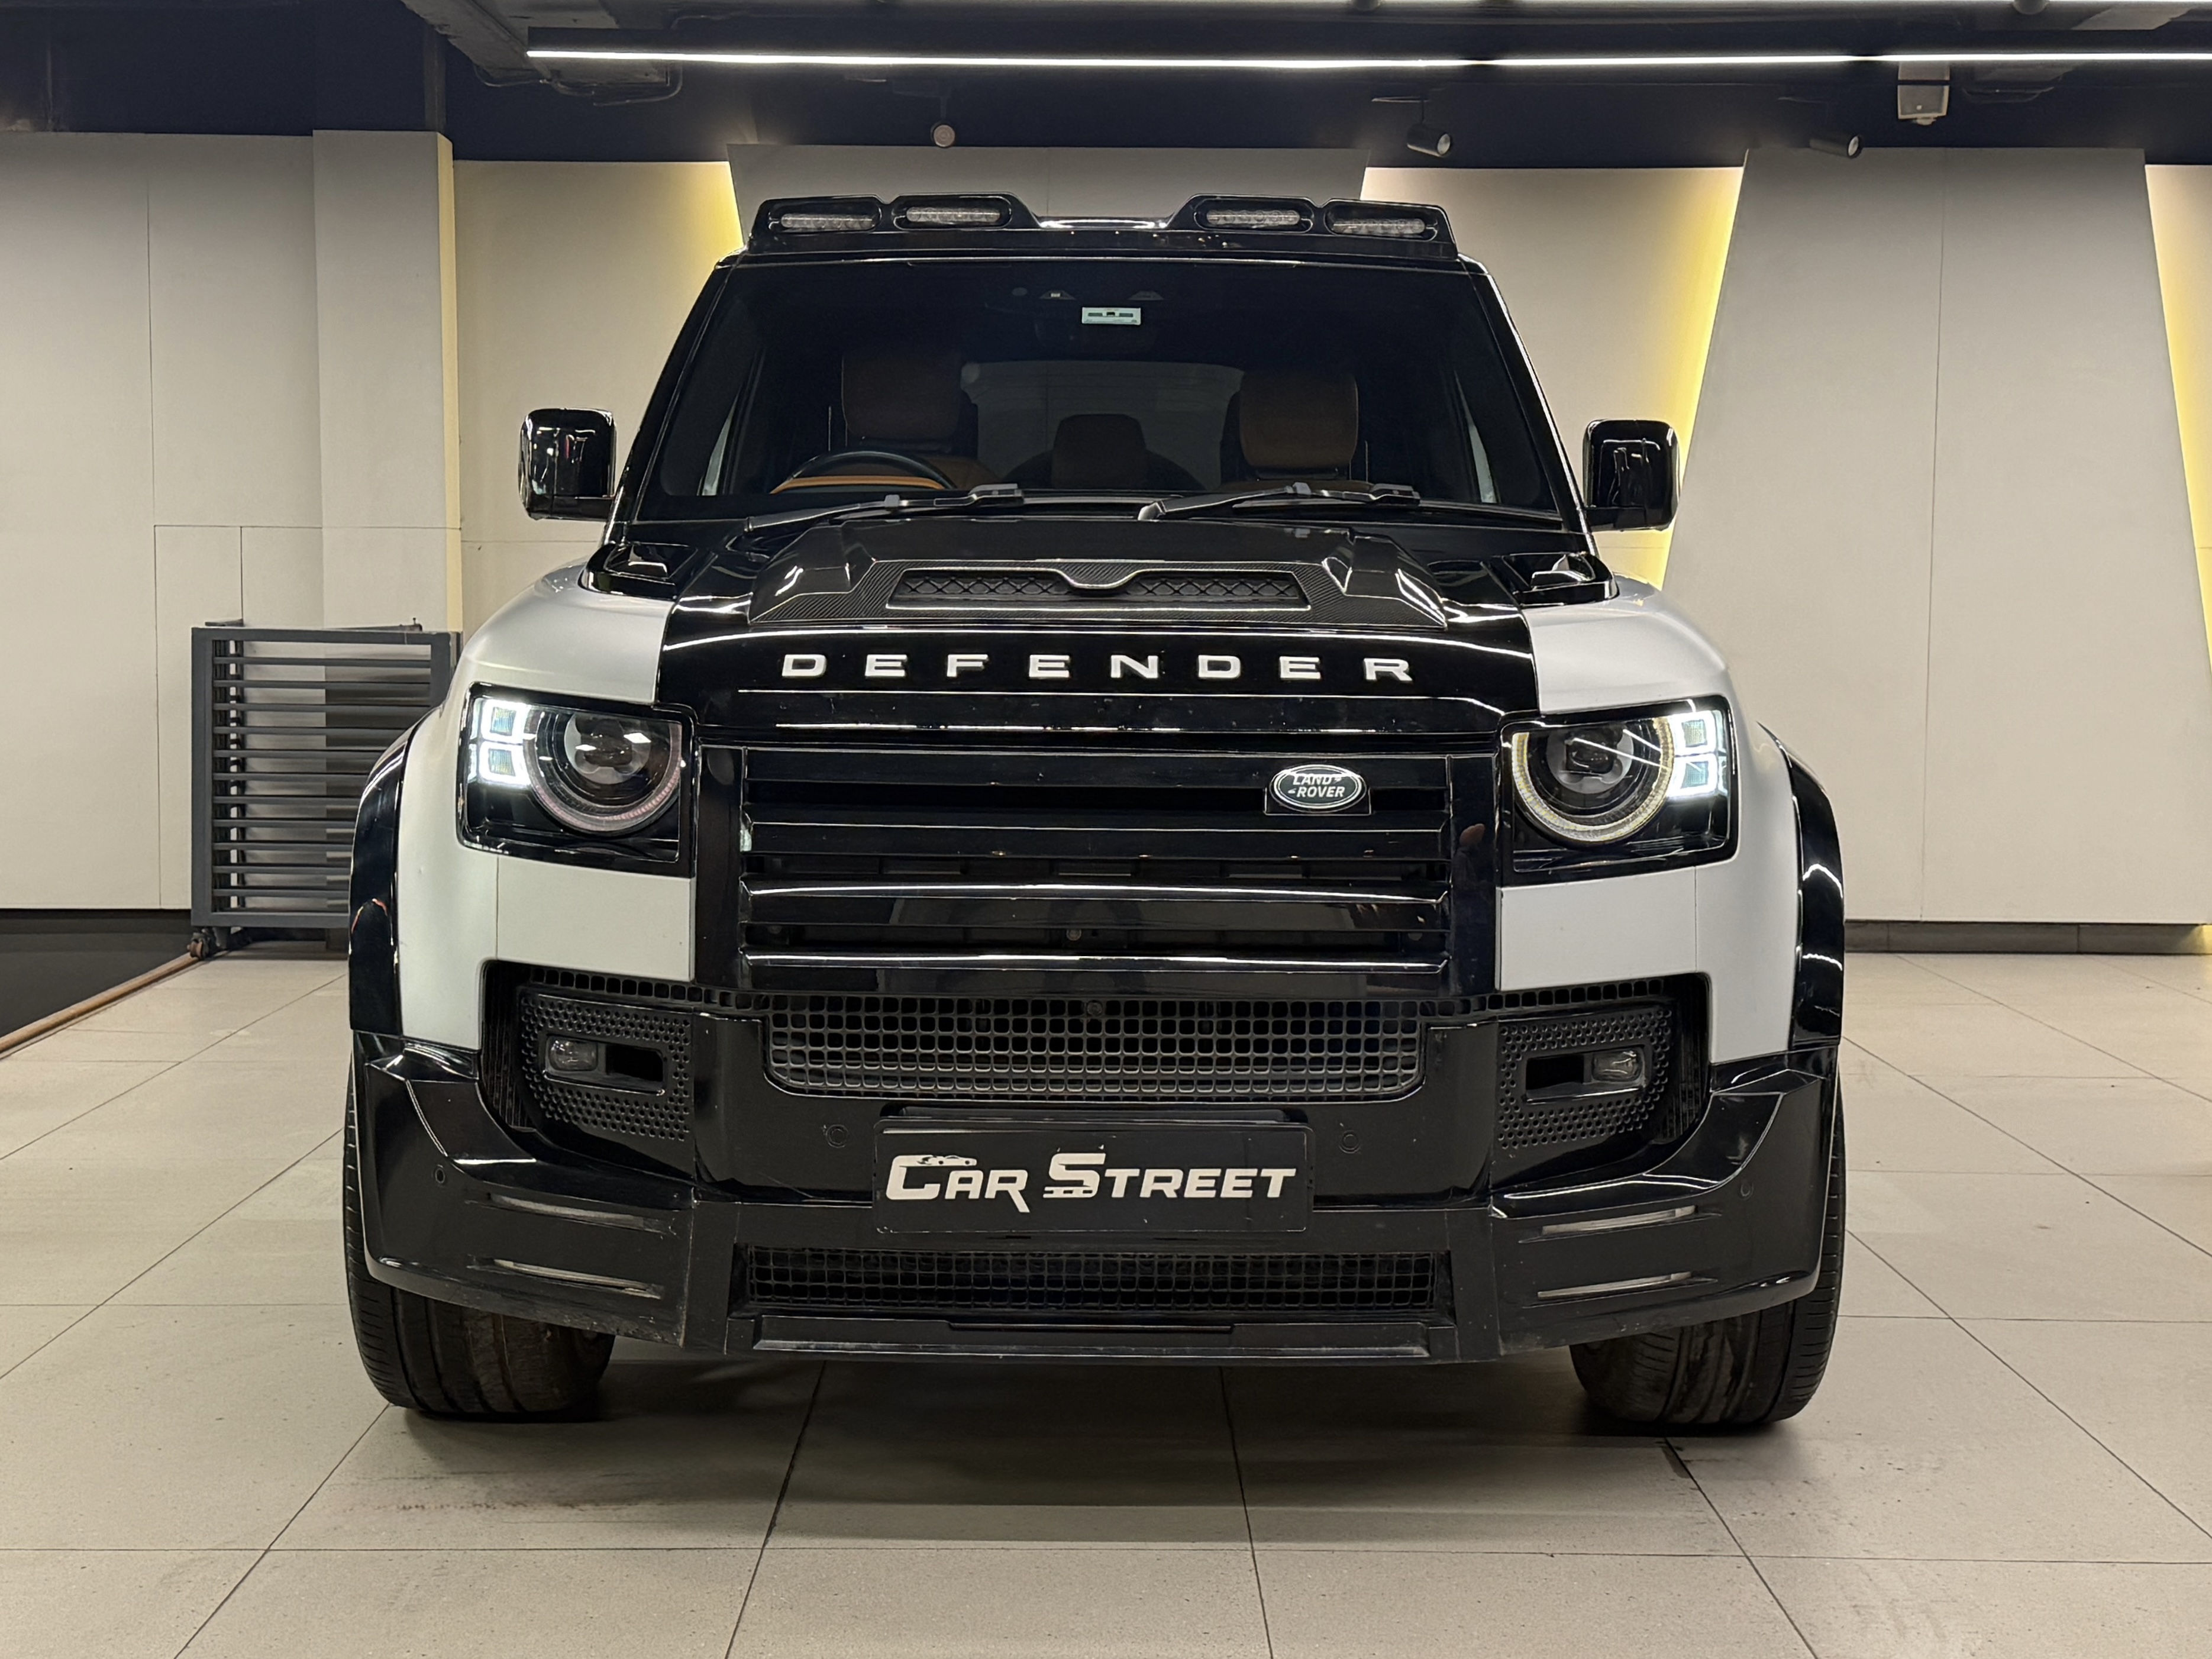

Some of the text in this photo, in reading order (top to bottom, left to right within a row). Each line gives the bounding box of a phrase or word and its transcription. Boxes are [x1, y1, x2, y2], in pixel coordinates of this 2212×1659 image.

[781, 653, 1413, 682] DEFENDER
[1292, 774, 1333, 786] LAND
[1296, 786, 1345, 798] ROVER
[886, 1152, 1297, 1213] CAR STREET
